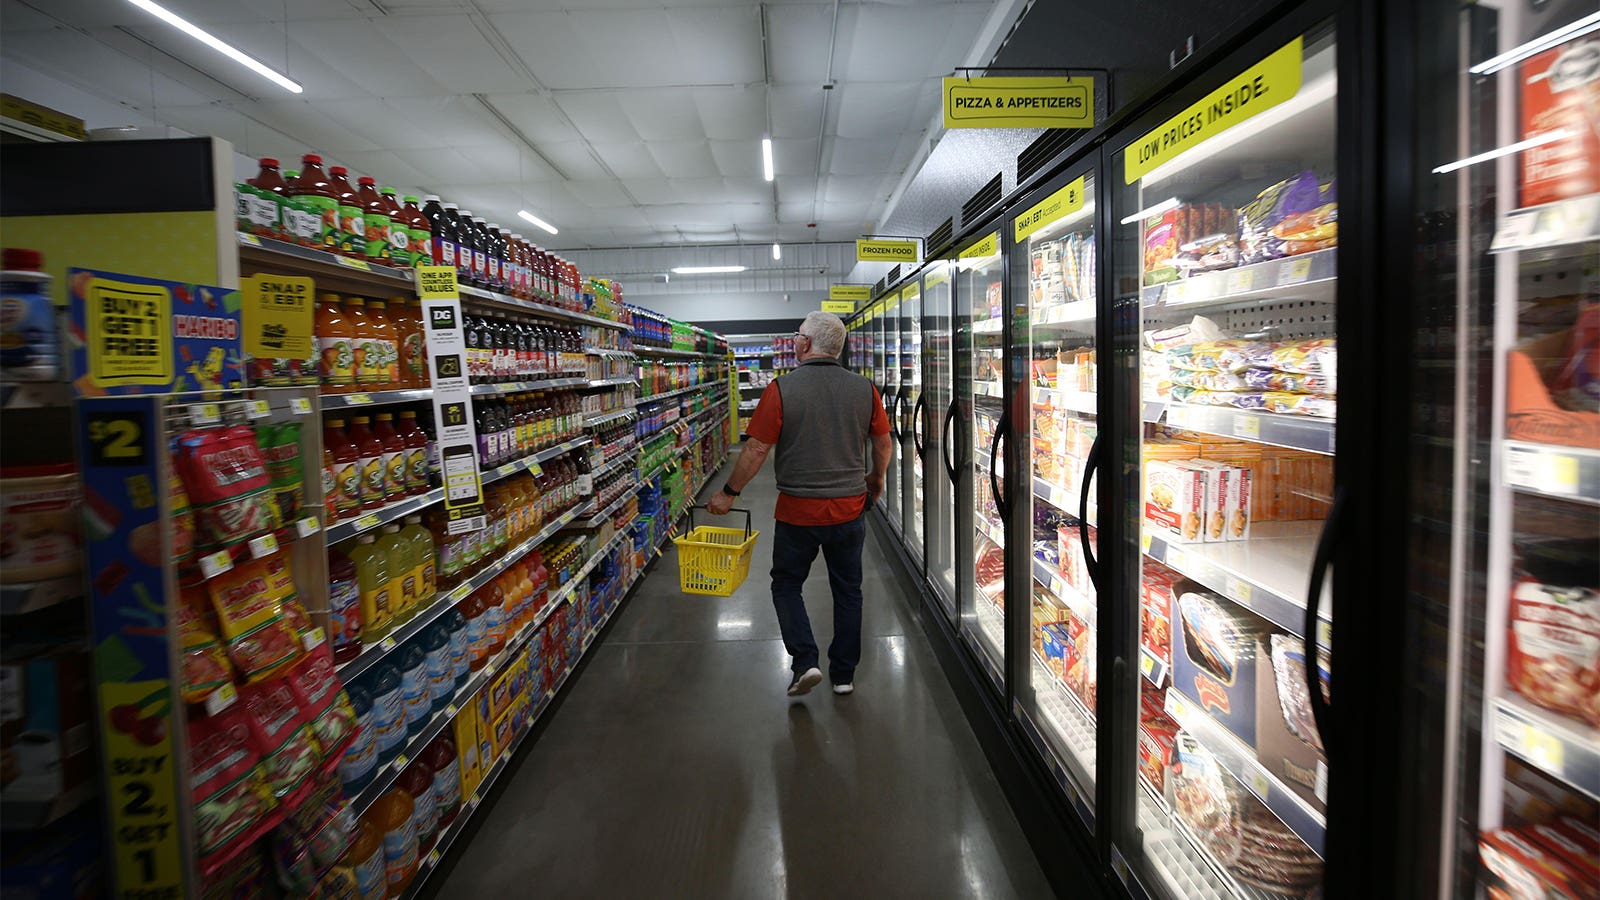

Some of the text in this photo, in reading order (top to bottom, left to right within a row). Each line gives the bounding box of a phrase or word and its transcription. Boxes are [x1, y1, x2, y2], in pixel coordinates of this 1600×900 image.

[955, 97, 1082, 109] PIZZA & APPETIZERS
[1139, 137, 1160, 164] LOW
[1163, 111, 1203, 150] PRICES
[1018, 217, 1032, 232] SNAP
[1033, 209, 1042, 223] EBT
[862, 246, 913, 255] FROZEN FOOD
[259, 282, 306, 294] SNAP
[102, 296, 142, 315] BUY
[274, 294, 306, 306] EBT
[433, 309, 452, 320] DG
[103, 316, 144, 335] GET
[173, 315, 238, 340] HARIBO
[103, 337, 160, 356] FREE
[88, 419, 144, 458] $2
[112, 755, 168, 775] BUY
[119, 823, 172, 845] GET
[133, 848, 158, 883] 1
